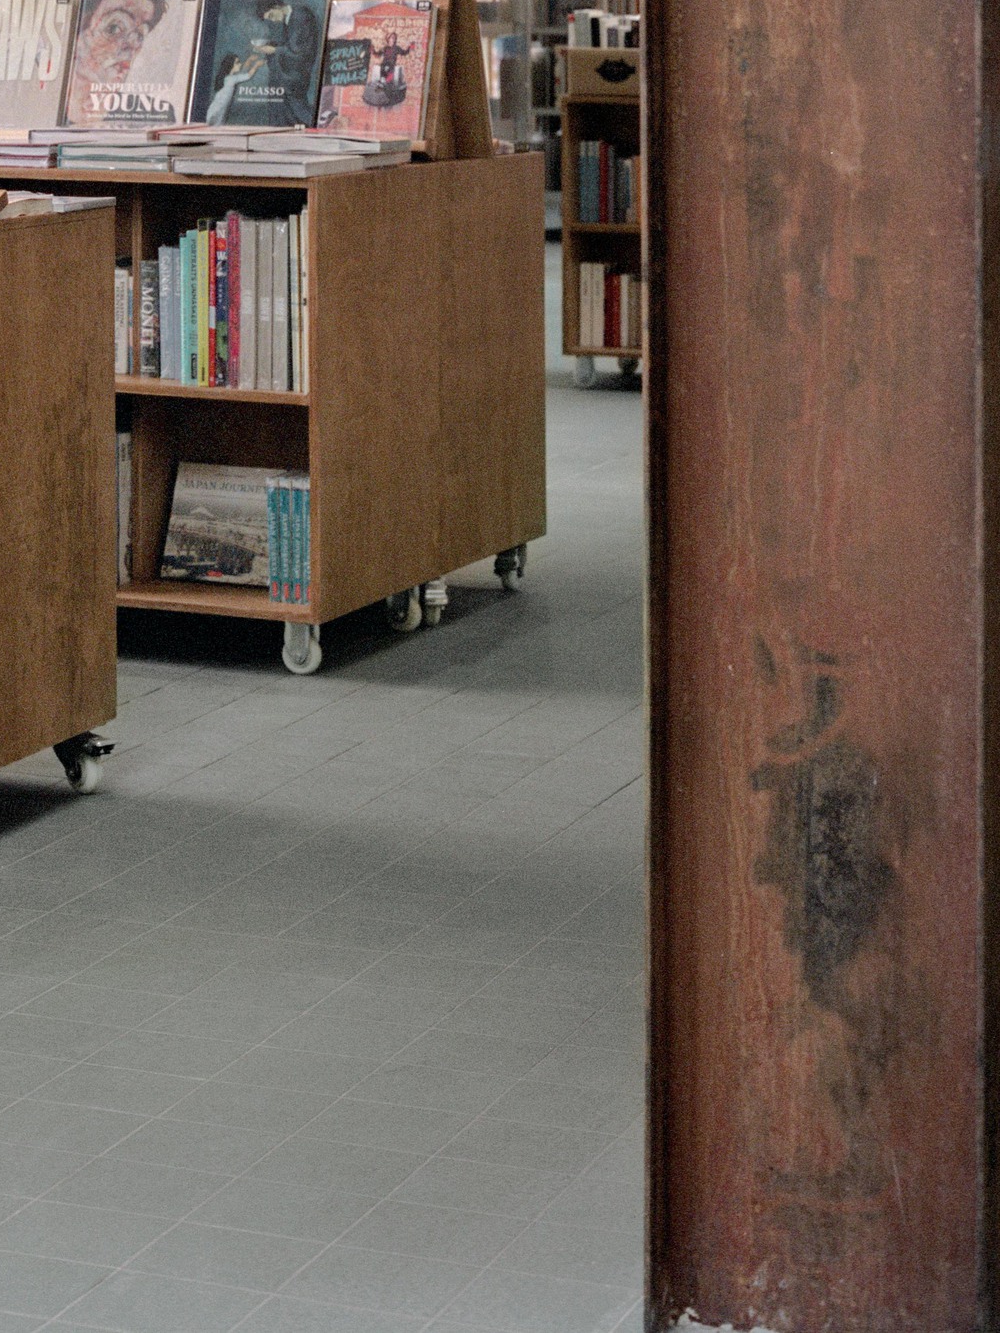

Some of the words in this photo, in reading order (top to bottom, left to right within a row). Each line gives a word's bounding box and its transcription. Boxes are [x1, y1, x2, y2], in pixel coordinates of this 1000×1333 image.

[330, 44, 364, 60] SPRAY
[238, 86, 285, 96] PICASSO
[89, 93, 170, 112] YOUNG
[141, 287, 154, 349] MONET
